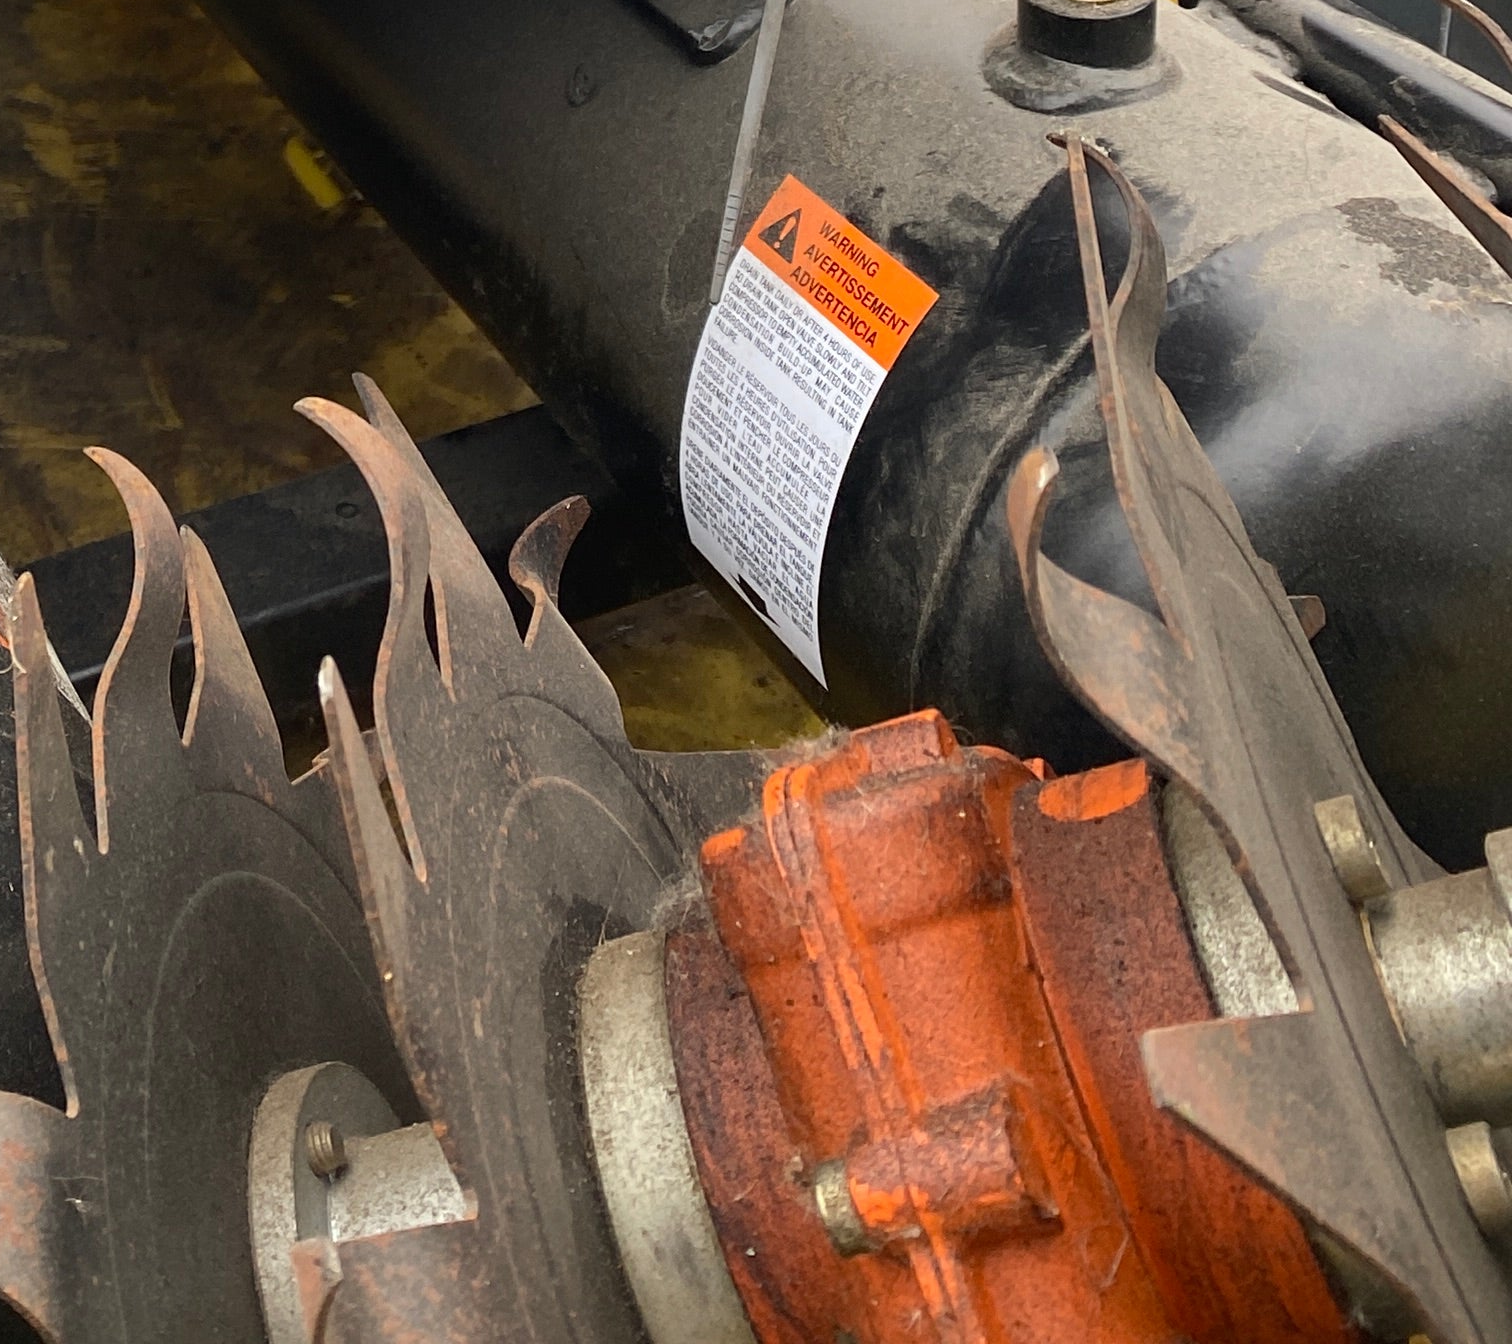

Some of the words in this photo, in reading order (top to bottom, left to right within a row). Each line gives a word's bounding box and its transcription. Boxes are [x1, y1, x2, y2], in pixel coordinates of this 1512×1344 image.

[803, 244, 909, 335] AVERTISSEMENT
[819, 220, 879, 277] WARNING
[790, 266, 879, 348] ADVERTENCIA
